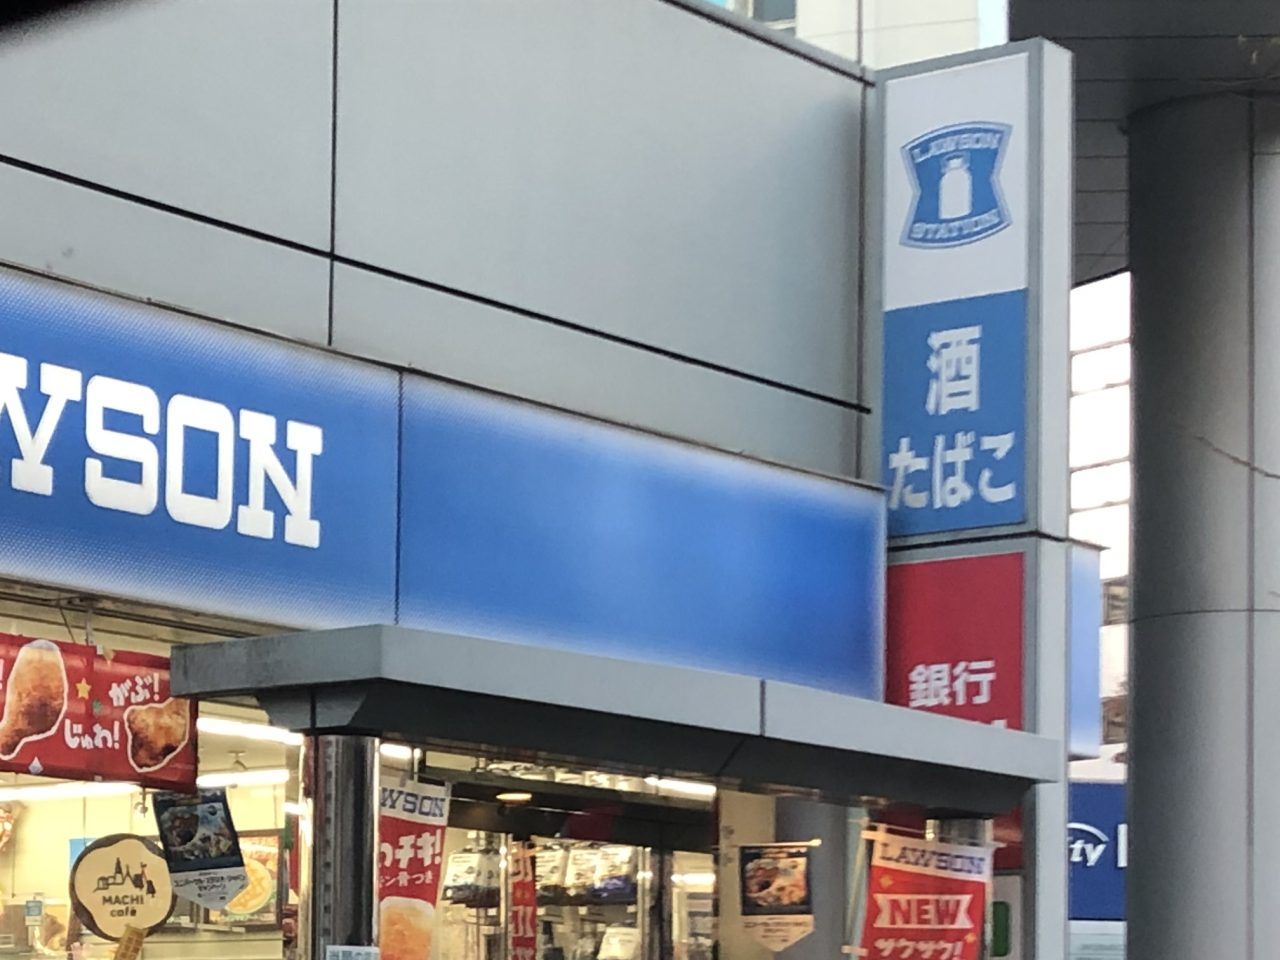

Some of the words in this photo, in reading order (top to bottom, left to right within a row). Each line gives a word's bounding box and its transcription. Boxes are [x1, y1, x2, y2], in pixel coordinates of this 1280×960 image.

[925, 325, 982, 416] 酒
[888, 431, 1016, 510] たばこ
[908, 660, 997, 708] 銀行
[878, 842, 987, 875] LAWSON
[102, 894, 145, 906] MACHI
[887, 897, 962, 927] NEW
